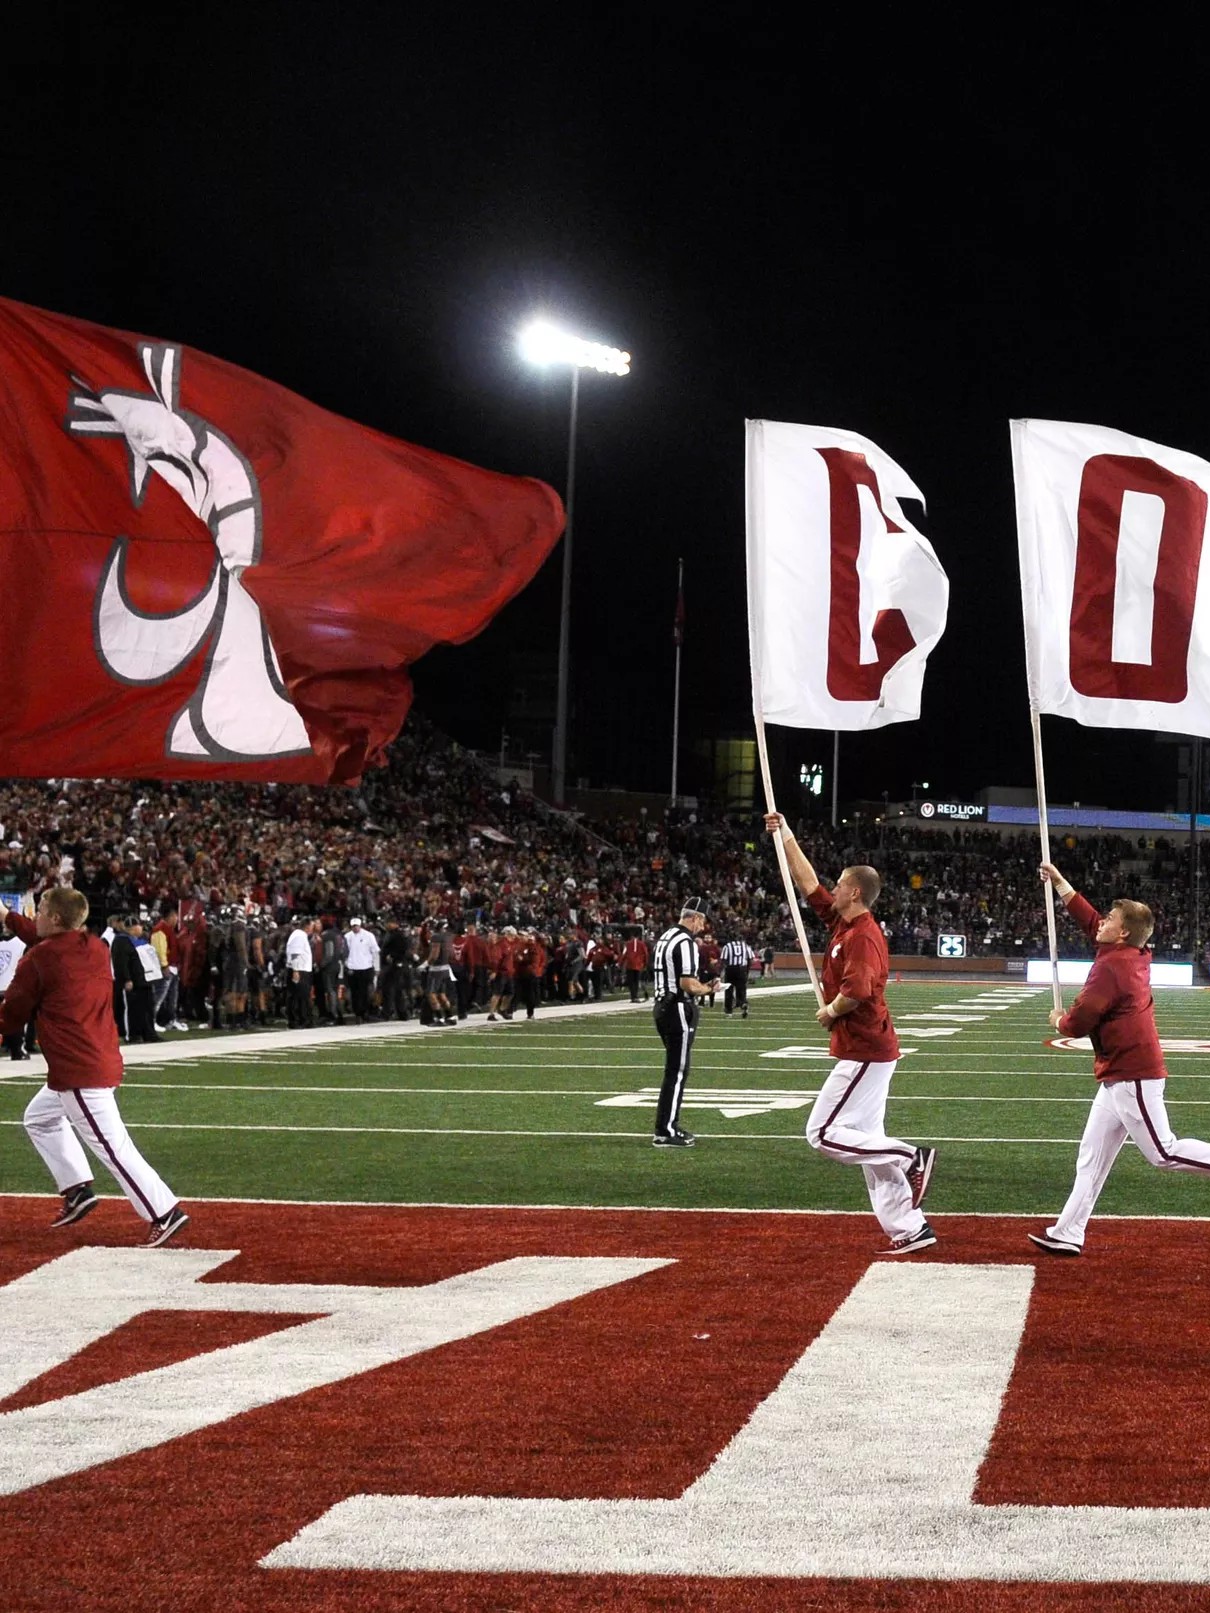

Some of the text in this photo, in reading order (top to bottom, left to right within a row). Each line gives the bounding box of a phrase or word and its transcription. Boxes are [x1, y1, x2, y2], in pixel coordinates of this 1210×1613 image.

[1069, 453, 1208, 704] O
[937, 803, 983, 815] RED LION
[940, 936, 963, 956] 25
